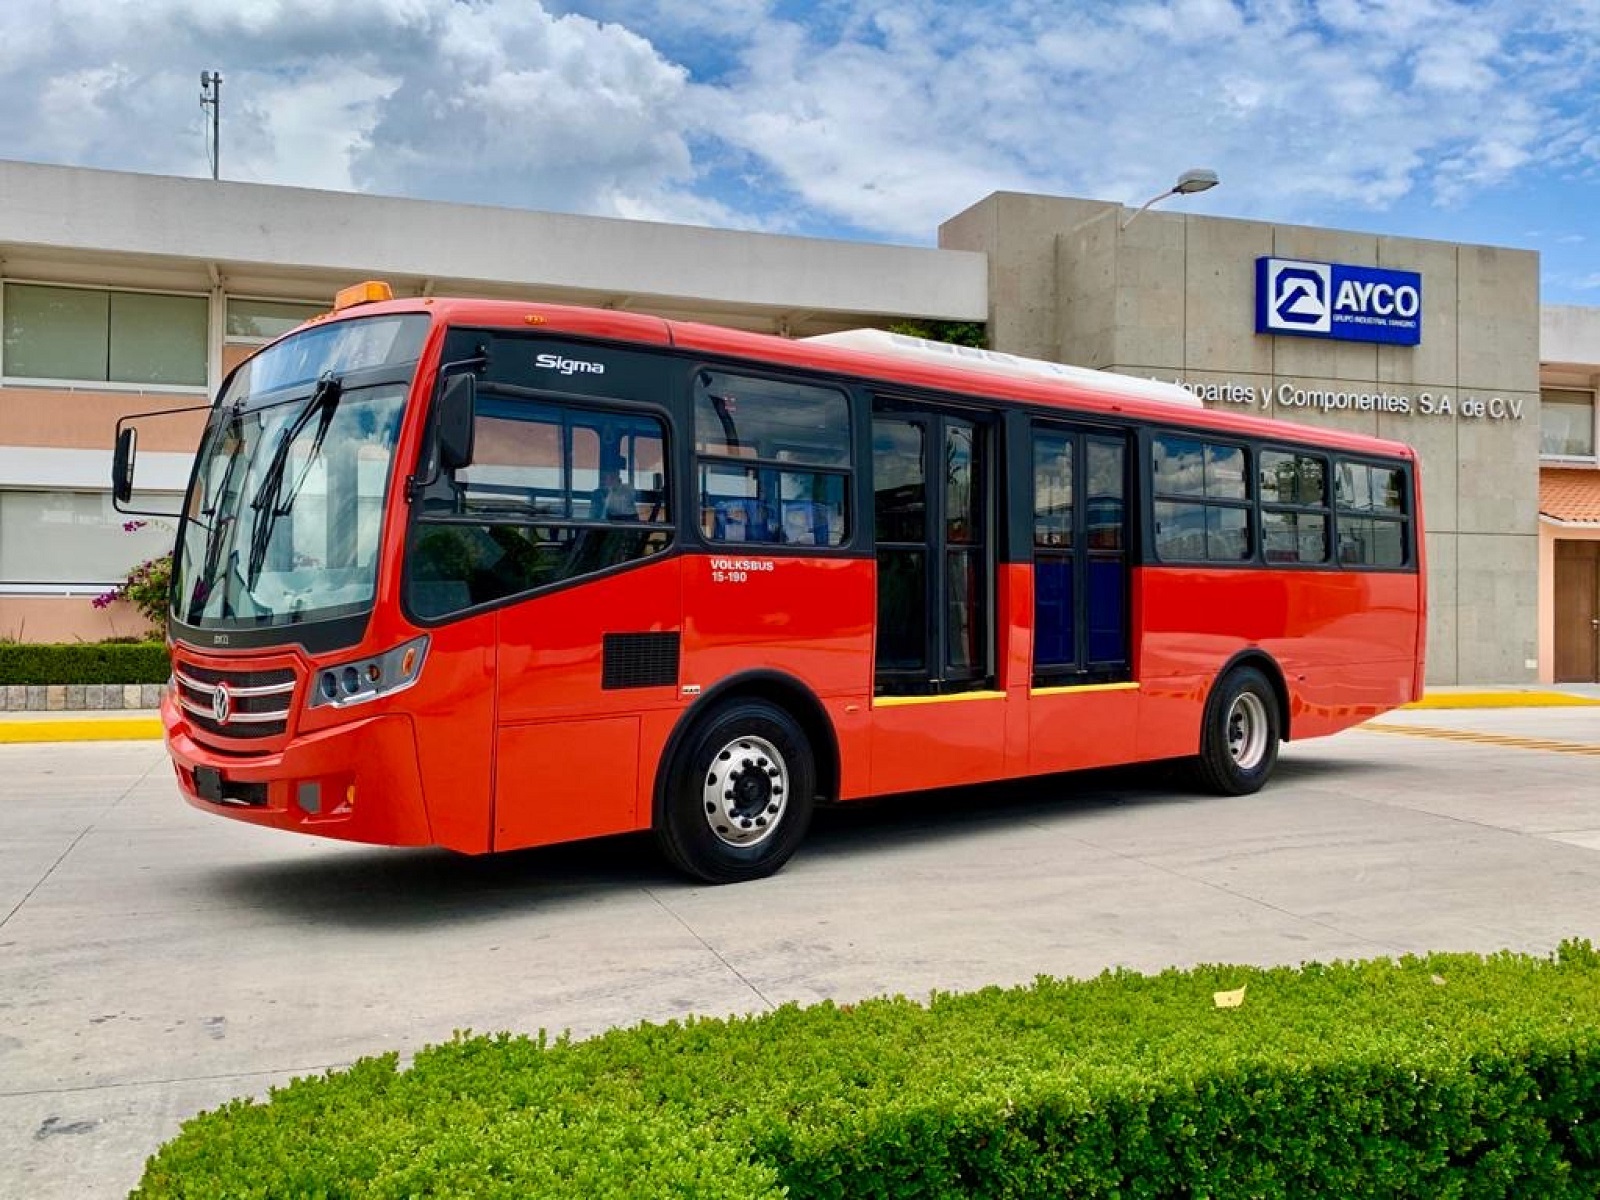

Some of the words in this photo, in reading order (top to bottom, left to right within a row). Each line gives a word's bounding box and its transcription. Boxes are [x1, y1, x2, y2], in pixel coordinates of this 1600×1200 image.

[1335, 280, 1419, 317] AYCO
[535, 354, 604, 375] Sigma
[1260, 388, 1273, 409] y
[1278, 383, 1414, 416] Componentes,
[1462, 397, 1485, 417] de
[1489, 397, 1525, 419] C.V.
[710, 559, 774, 571] VOLKSBUS
[711, 571, 747, 582] 15-190
